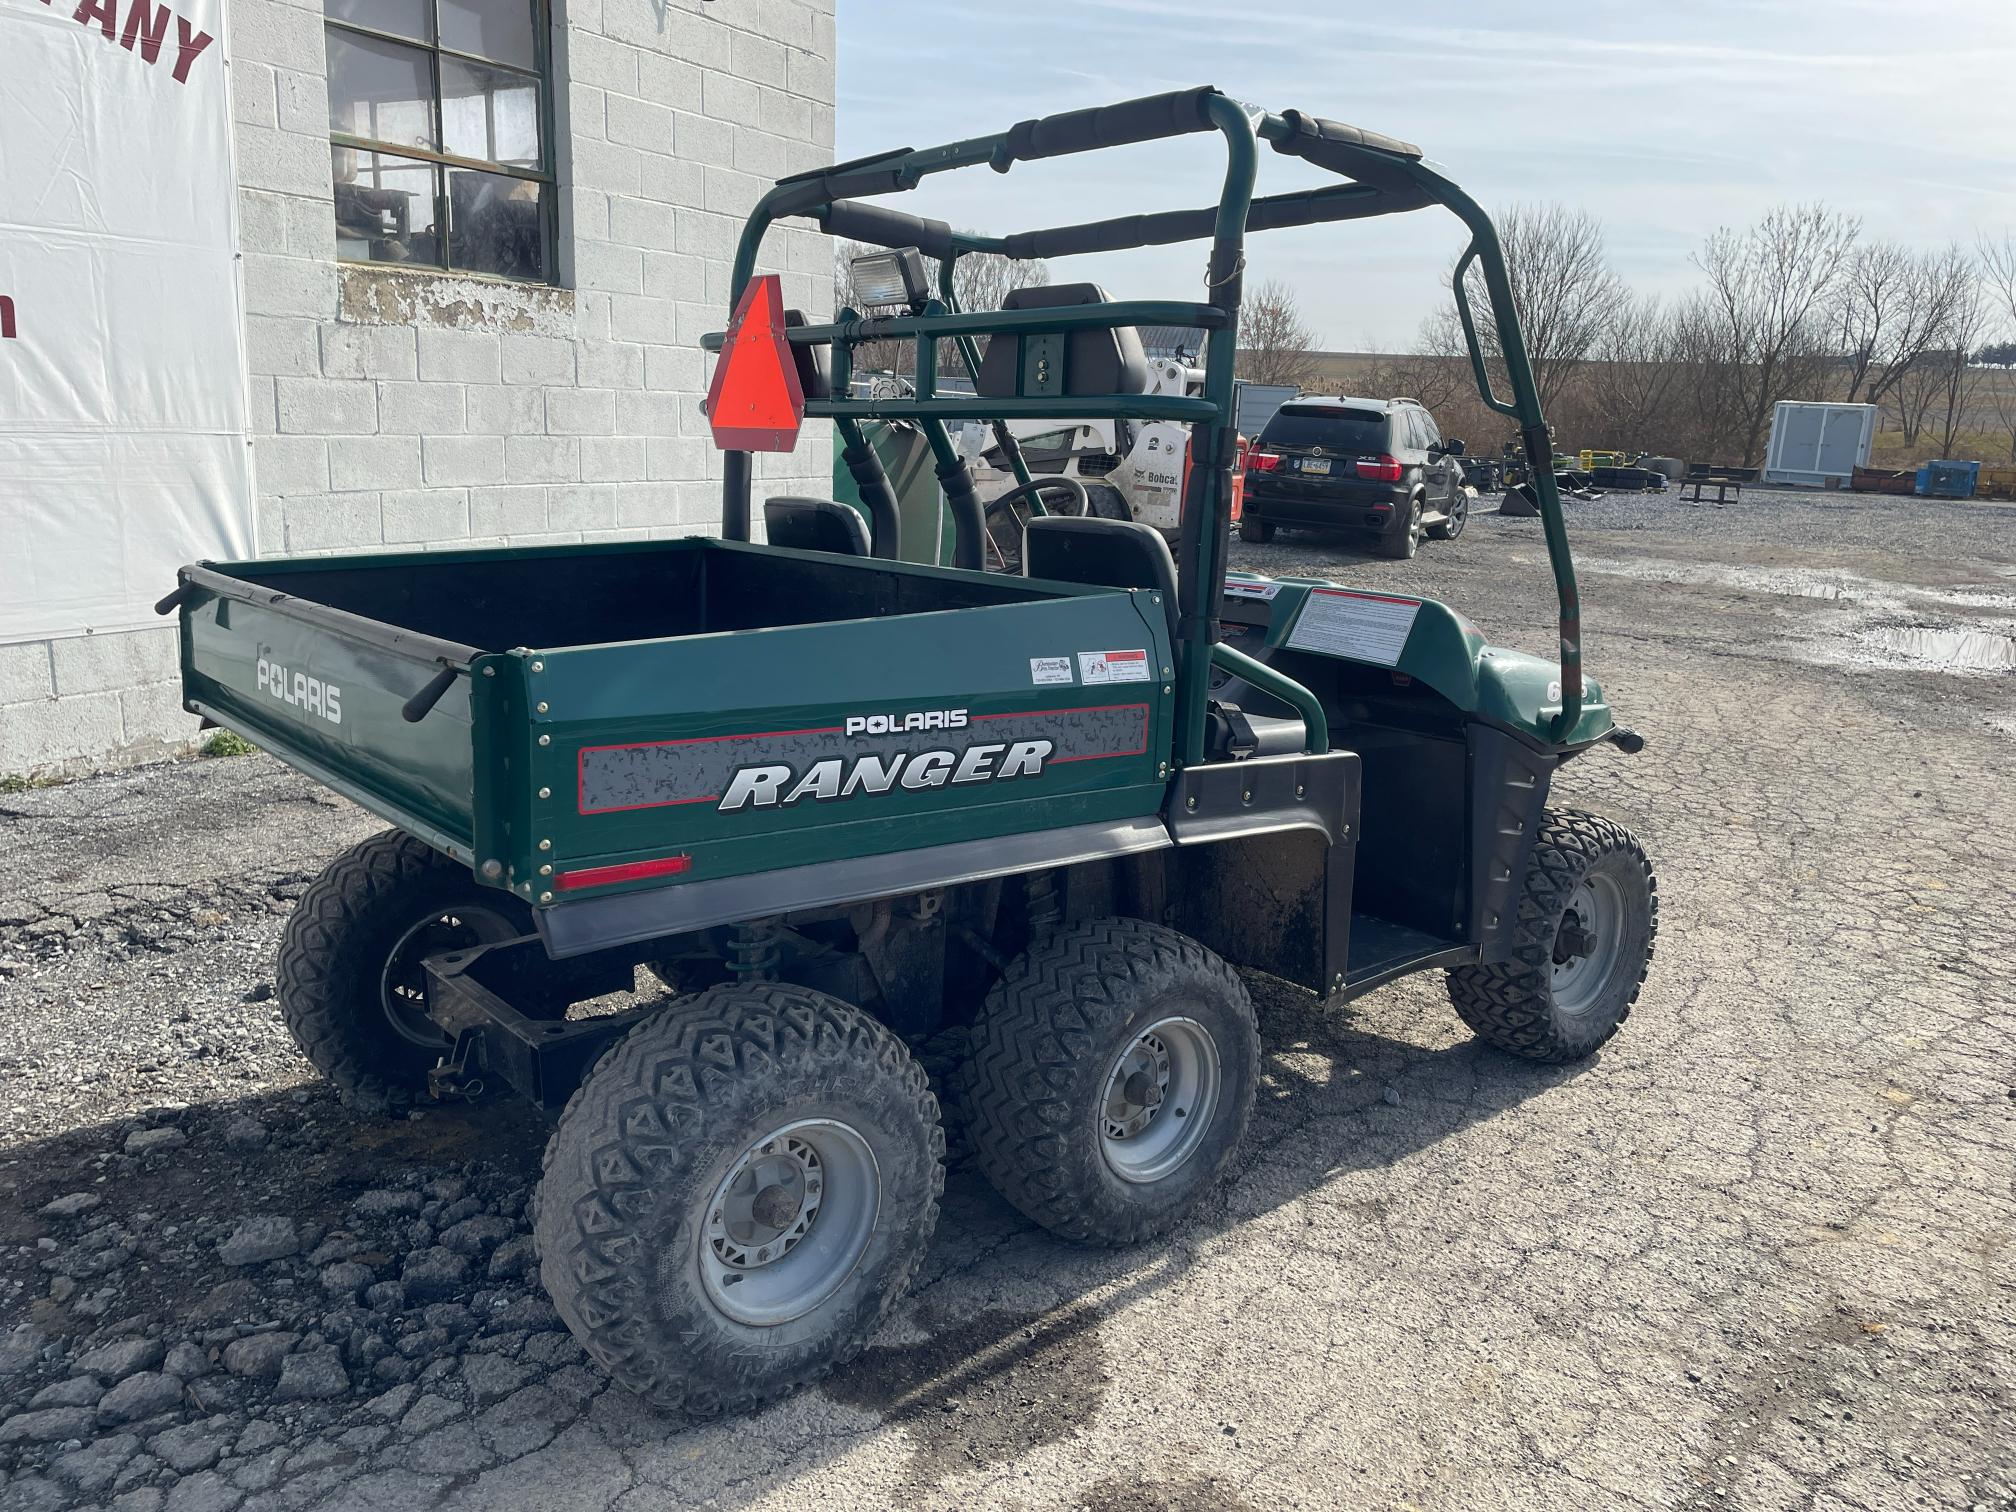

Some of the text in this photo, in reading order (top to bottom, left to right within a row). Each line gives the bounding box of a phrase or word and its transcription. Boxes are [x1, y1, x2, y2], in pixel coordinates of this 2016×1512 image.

[1148, 437, 1160, 451] 2
[257, 658, 342, 725] POLARIS
[846, 709, 968, 736] POLARIS
[717, 739, 1053, 811] RANGER
